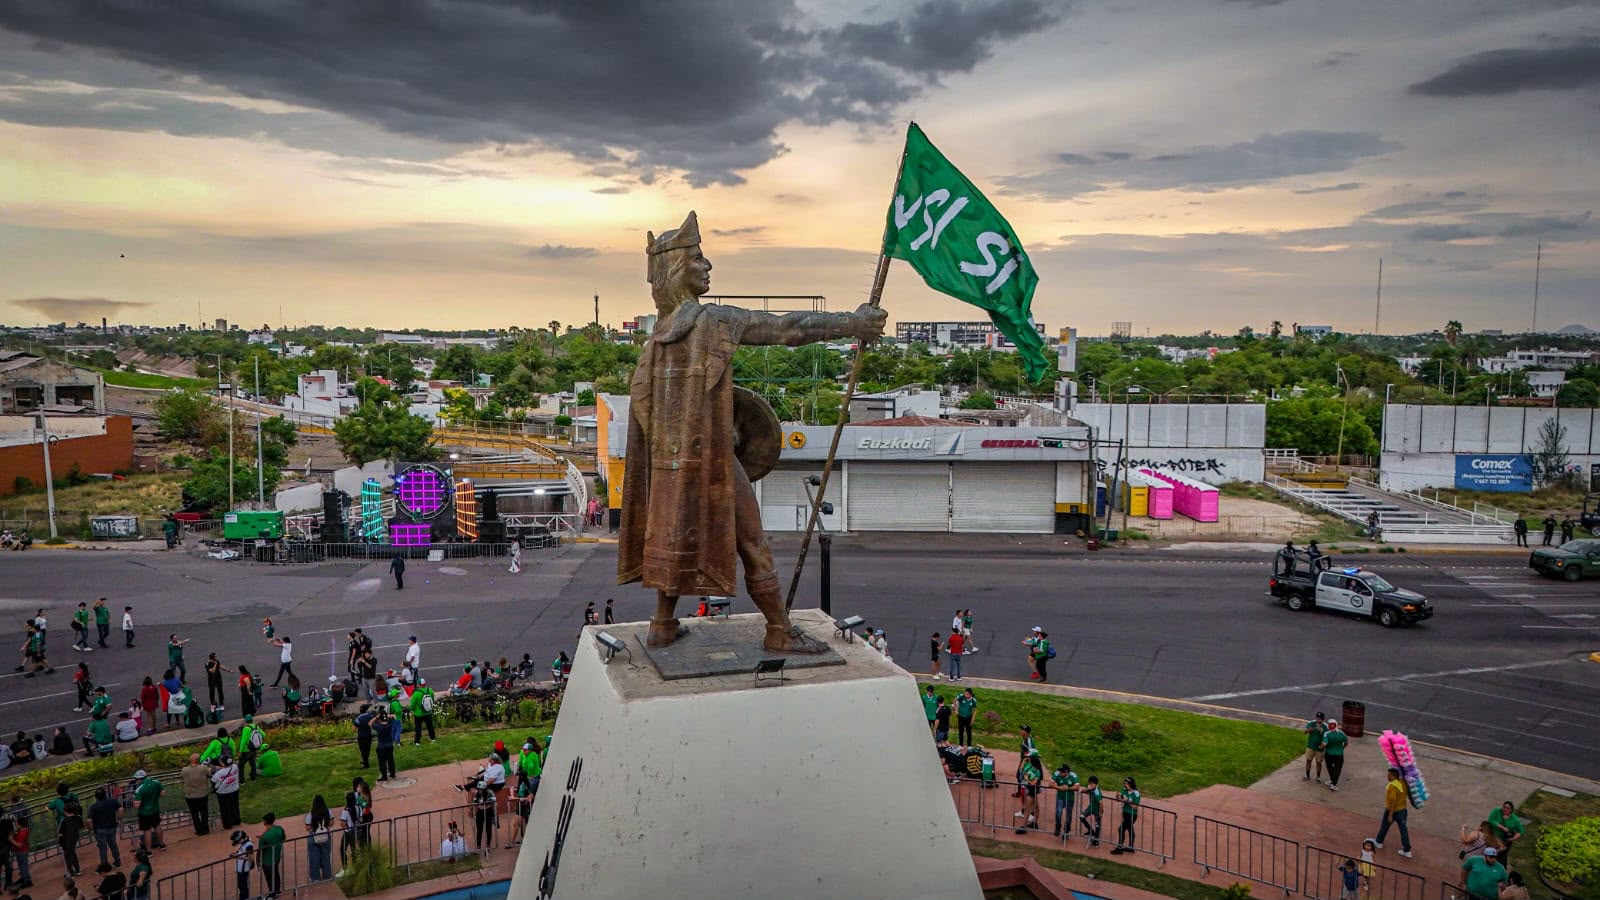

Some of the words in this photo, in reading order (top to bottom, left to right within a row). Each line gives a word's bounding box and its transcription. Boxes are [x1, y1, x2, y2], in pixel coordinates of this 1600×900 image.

[857, 437, 931, 450] Euzkadi
[981, 439, 1039, 449] GENERAL
[1471, 458, 1516, 469] Comex
